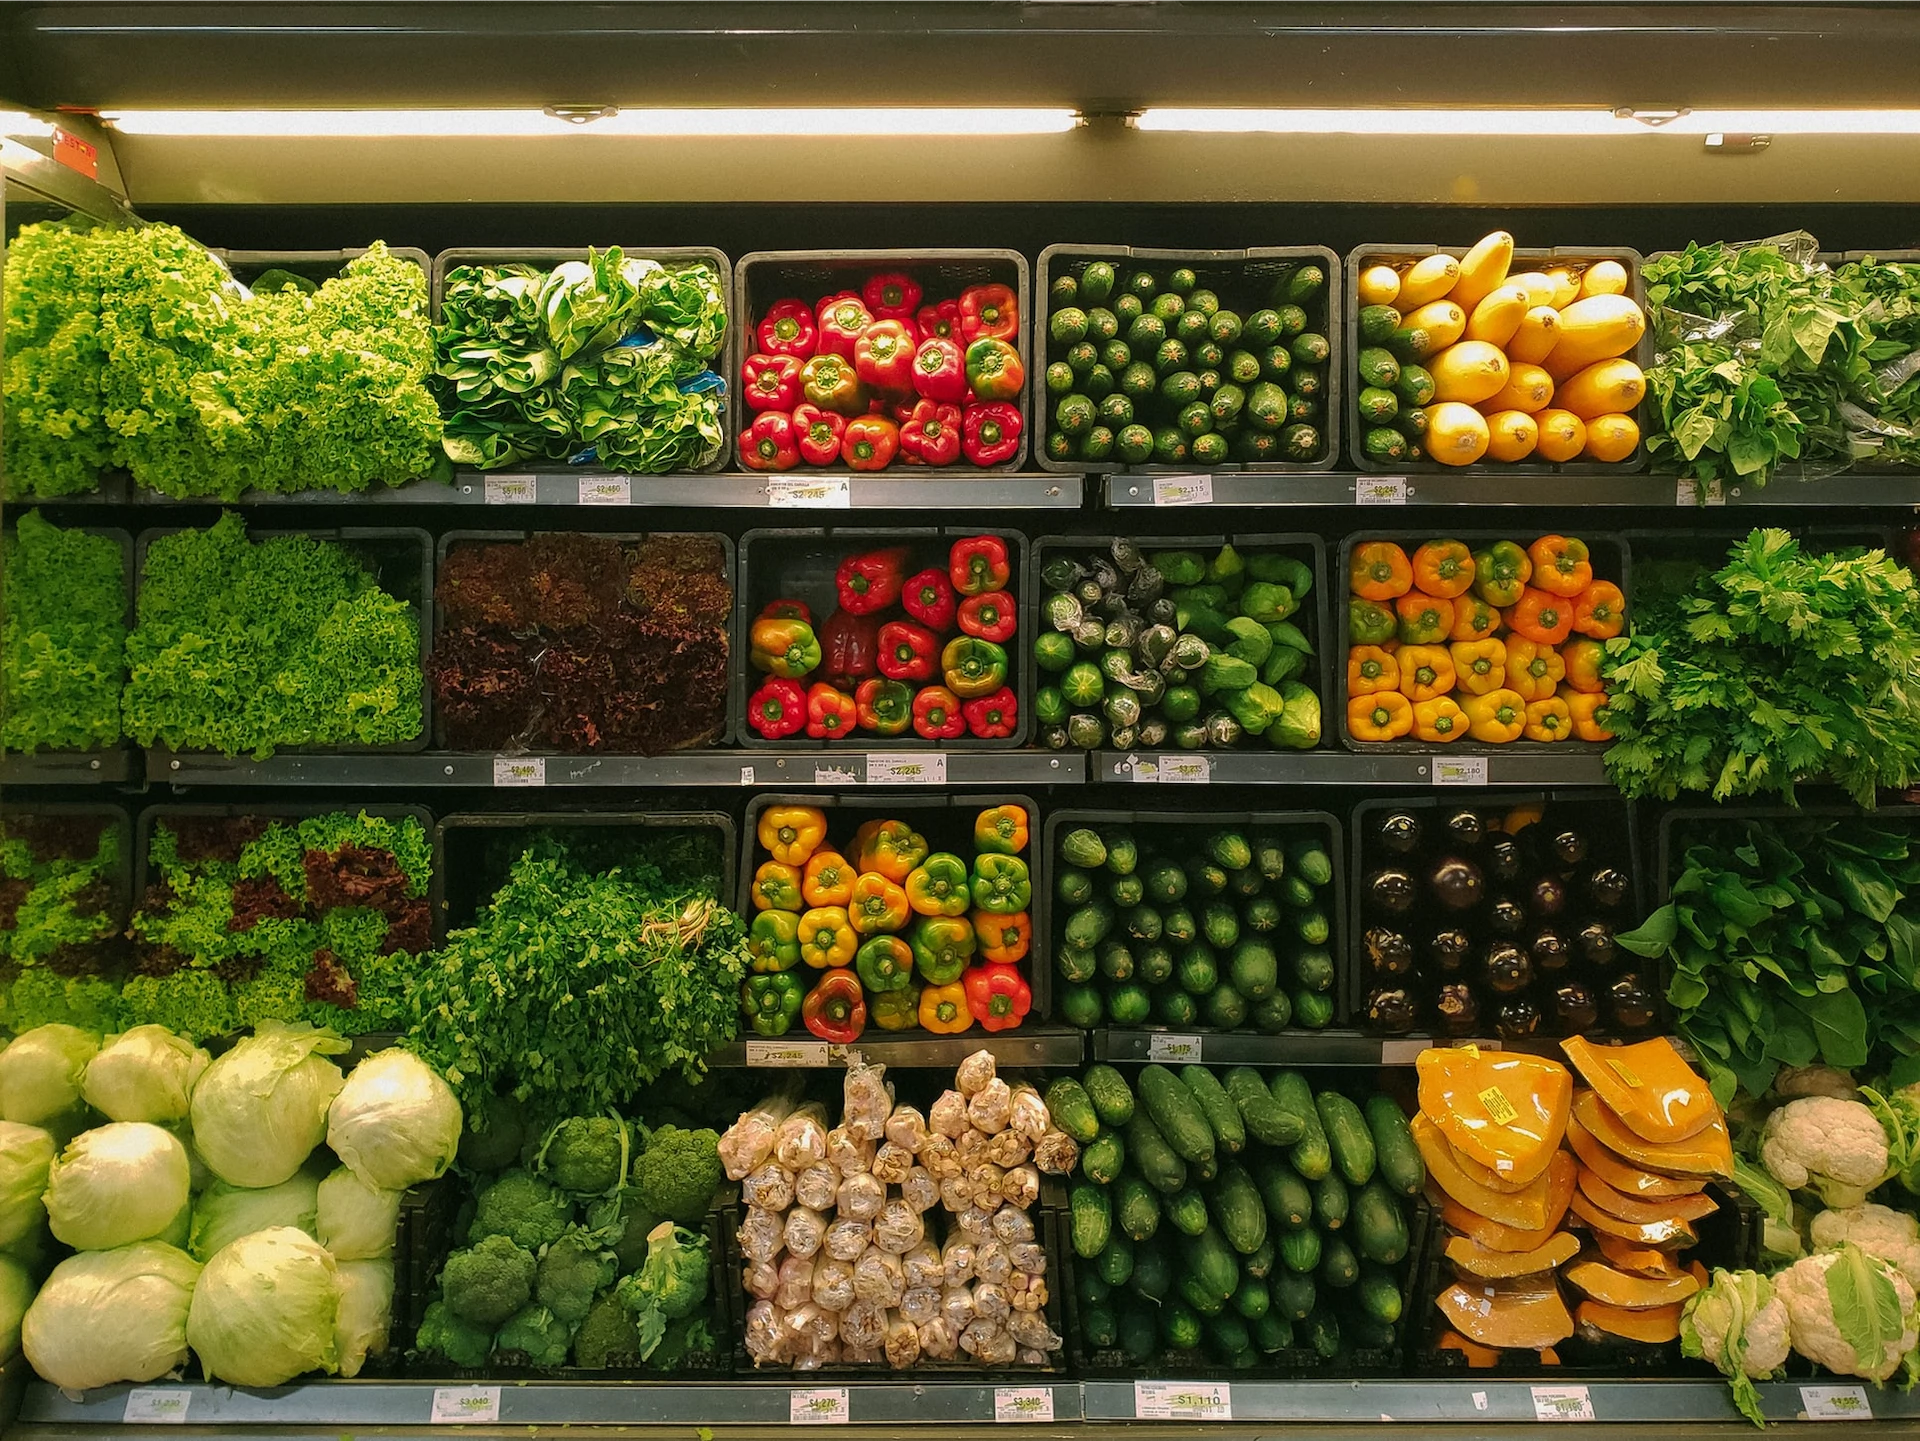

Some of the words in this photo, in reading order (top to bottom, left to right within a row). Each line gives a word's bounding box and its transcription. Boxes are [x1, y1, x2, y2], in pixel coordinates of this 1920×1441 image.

[841, 482, 848, 491] A
[793, 490, 825, 499] $2245
[937, 758, 944, 767] A
[890, 766, 922, 776] $2,245
[1045, 1389, 1051, 1398] A
[809, 1398, 836, 1409] $4,270
